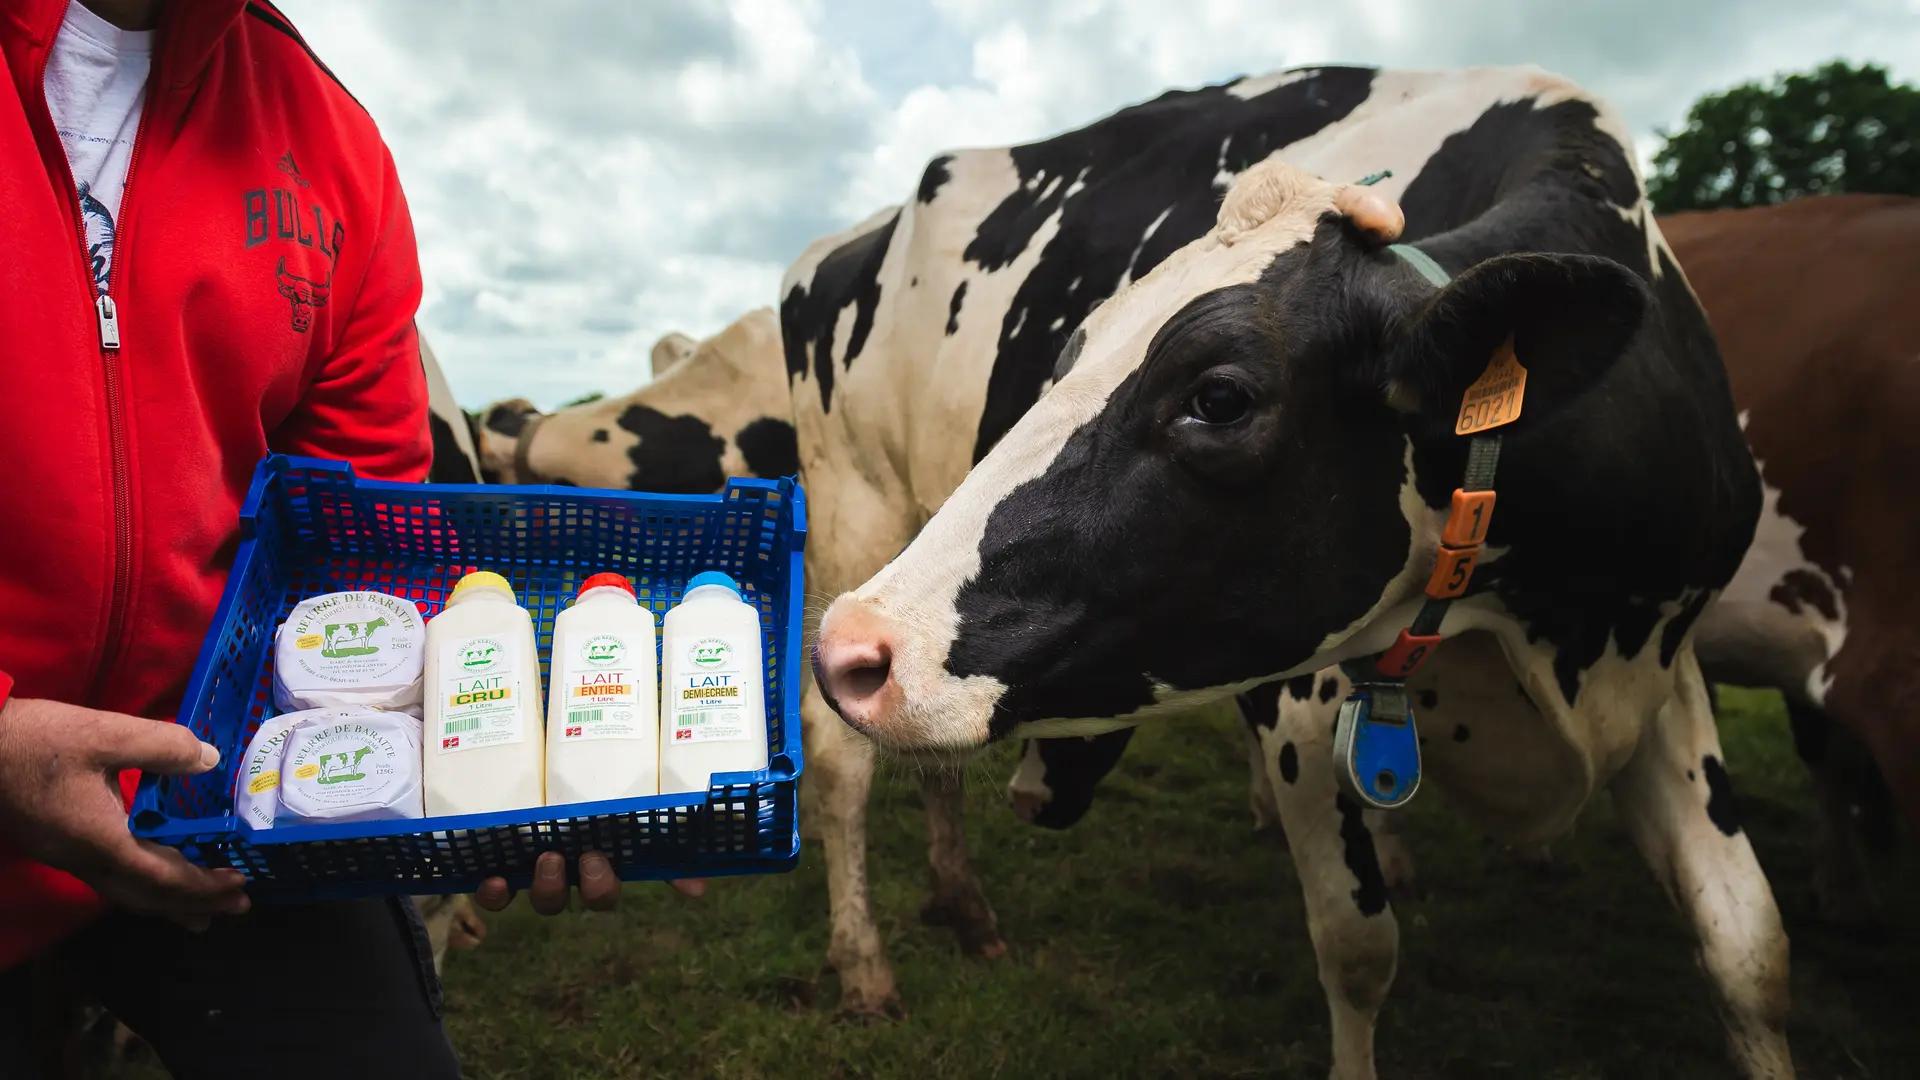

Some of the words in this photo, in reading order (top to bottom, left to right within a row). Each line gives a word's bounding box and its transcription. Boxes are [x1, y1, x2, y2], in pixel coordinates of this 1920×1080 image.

[1461, 390, 1515, 430] 6021
[1471, 501, 1484, 541] 1
[1447, 556, 1471, 590] 5
[296, 596, 341, 635] BEURRE
[344, 593, 364, 603] DE
[368, 593, 415, 631] BARATTE
[391, 642, 412, 650] 250G
[459, 676, 502, 693] LAIT
[582, 673, 624, 685] LAIT
[690, 675, 731, 688] LAIT
[456, 689, 504, 705] CRU
[581, 685, 623, 696] ENTIER
[295, 728, 331, 765] BEURRE
[334, 724, 351, 734] DE
[354, 724, 396, 758] BARATTE
